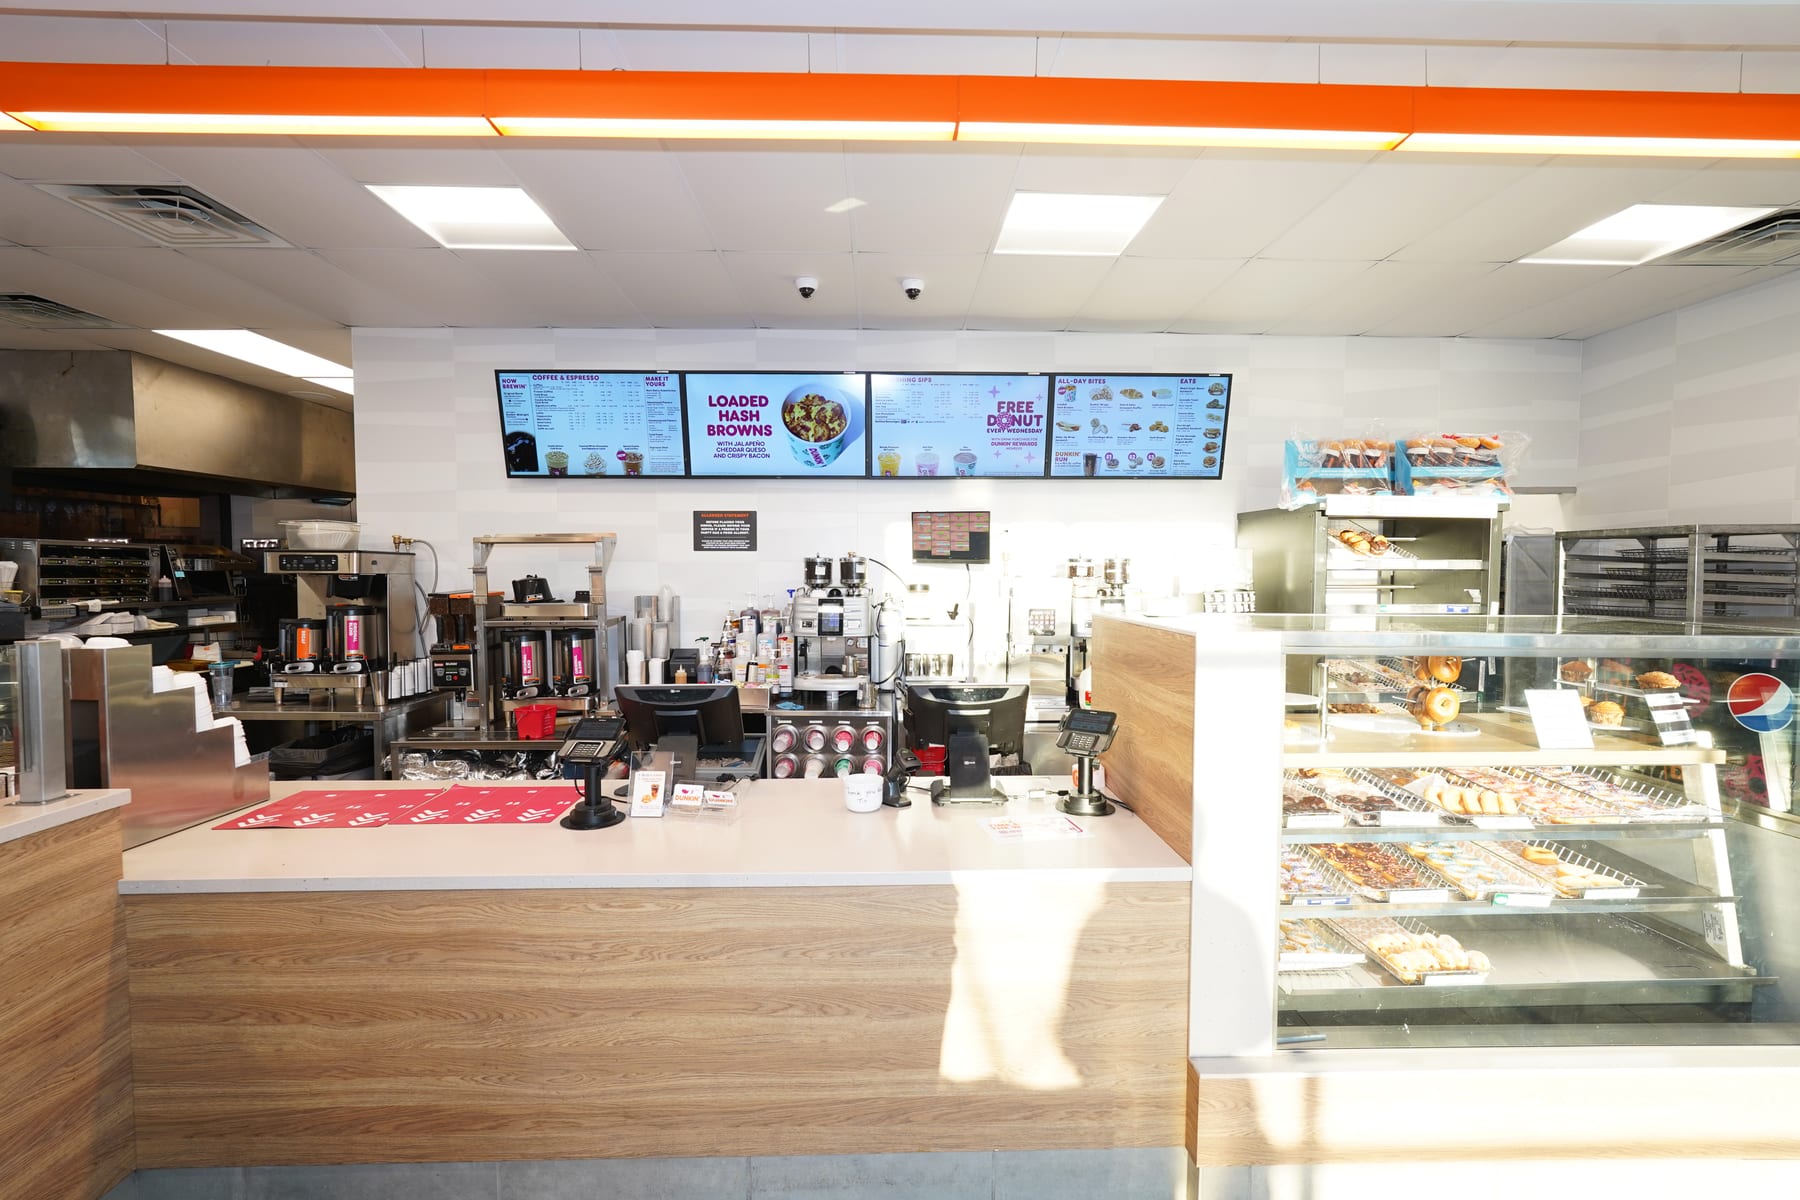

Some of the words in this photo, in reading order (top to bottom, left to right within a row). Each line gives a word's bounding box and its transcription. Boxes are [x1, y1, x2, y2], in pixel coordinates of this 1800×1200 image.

[708, 395, 769, 407] LOADED
[997, 401, 1034, 413] FREE
[718, 410, 760, 422] HASH
[987, 414, 1043, 427] DONUT
[707, 424, 772, 436] BROWNS
